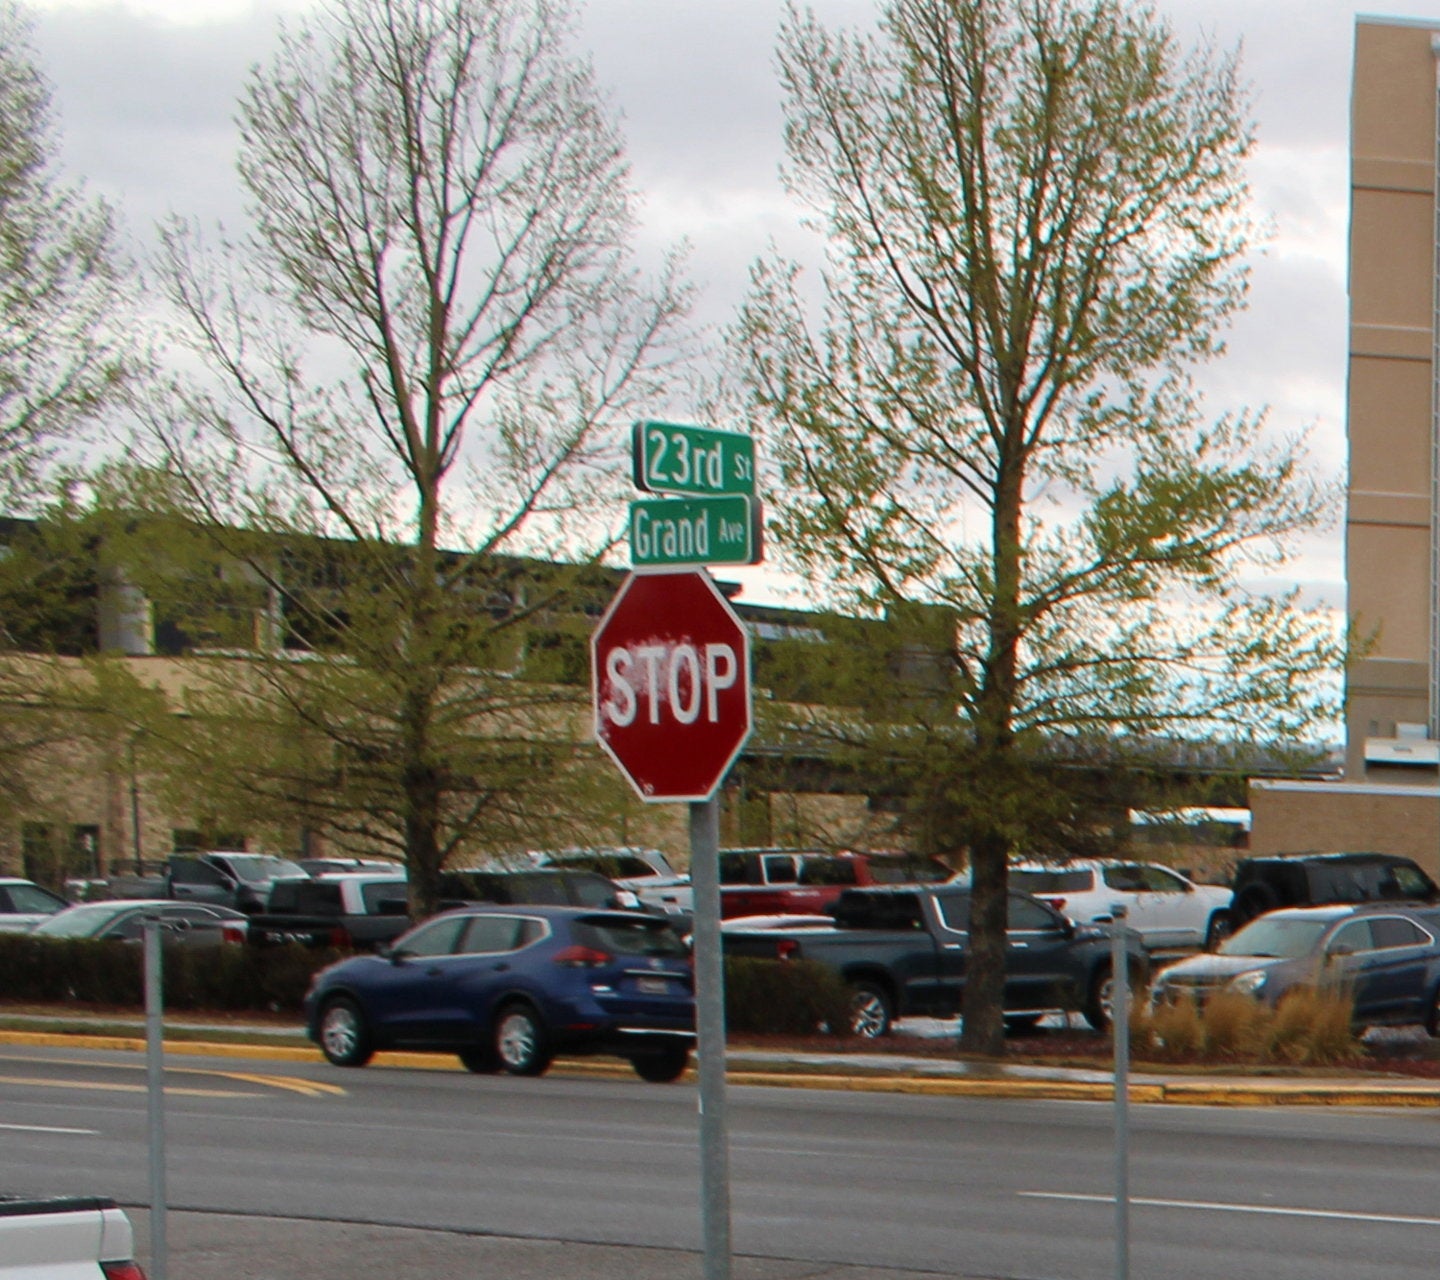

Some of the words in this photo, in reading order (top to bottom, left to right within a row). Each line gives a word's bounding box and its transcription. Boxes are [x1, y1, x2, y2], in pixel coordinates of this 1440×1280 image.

[648, 429, 723, 489] 23rd
[734, 454, 753, 481] St
[633, 508, 709, 558] Grand
[718, 517, 744, 544] Ave
[605, 642, 738, 727] STOP
